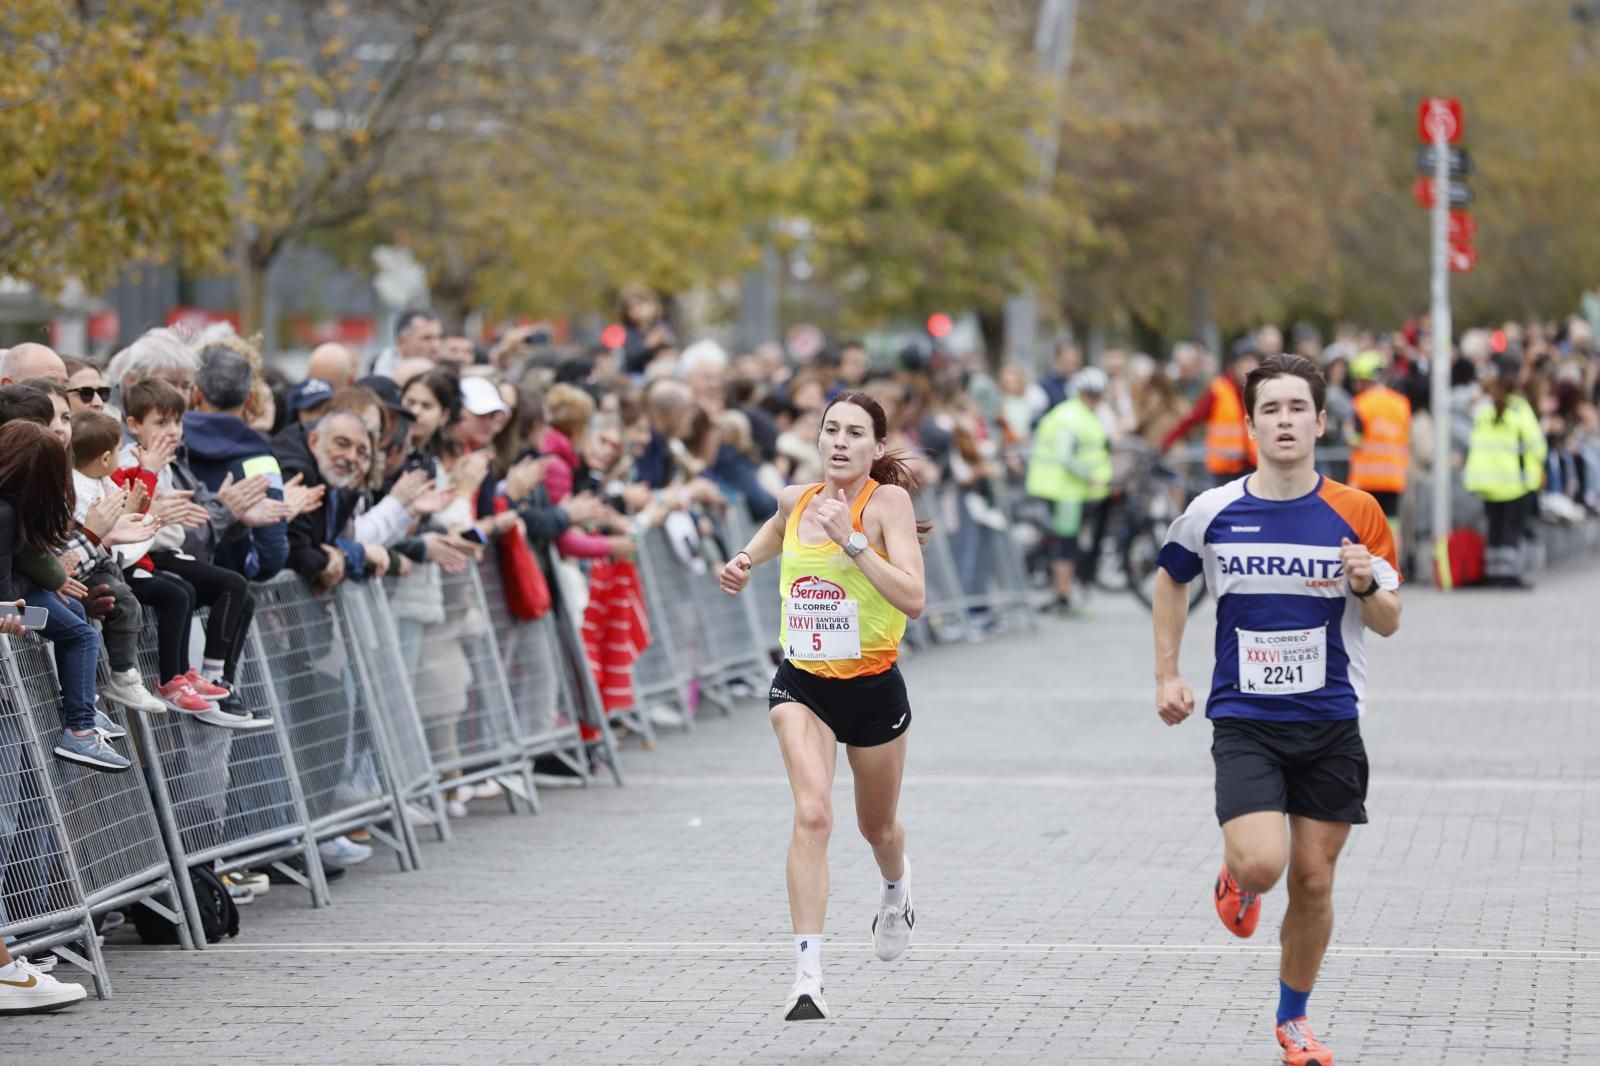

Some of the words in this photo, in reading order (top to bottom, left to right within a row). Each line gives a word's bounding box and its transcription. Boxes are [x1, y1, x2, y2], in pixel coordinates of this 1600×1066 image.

[794, 584, 840, 600] Serrano
[802, 603, 838, 611] CORREO
[788, 615, 814, 630] XXXVI
[812, 633, 822, 652] 5
[1255, 636, 1265, 644] EL
[1267, 635, 1308, 644] CORREO
[1247, 648, 1281, 663] XXXVI
[1282, 646, 1319, 655] SANTURCE
[1283, 652, 1320, 662] BILBAO
[1264, 665, 1304, 685] 2241
